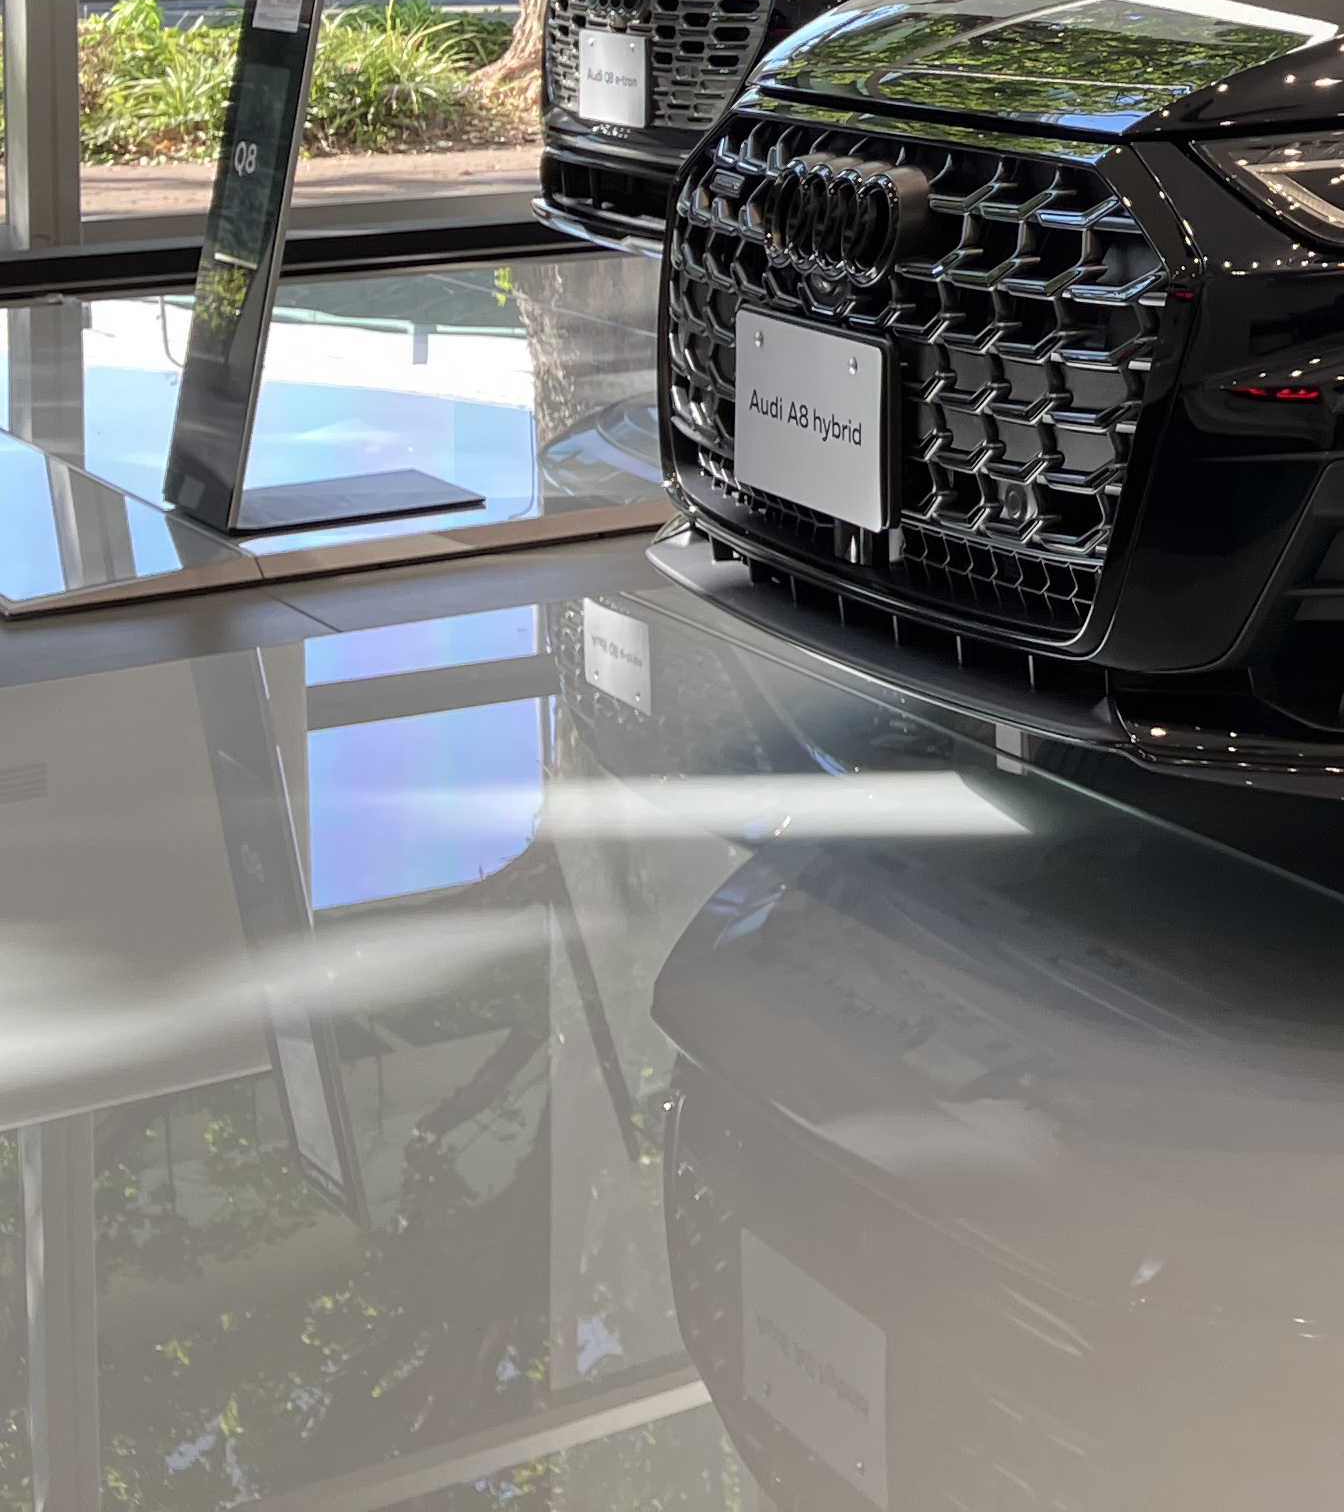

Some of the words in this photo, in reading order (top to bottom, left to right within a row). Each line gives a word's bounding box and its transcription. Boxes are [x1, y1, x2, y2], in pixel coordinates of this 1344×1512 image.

[234, 140, 258, 178] Q8
[749, 389, 783, 420] Audi
[787, 401, 809, 430] A8
[813, 408, 862, 447] hybrid
